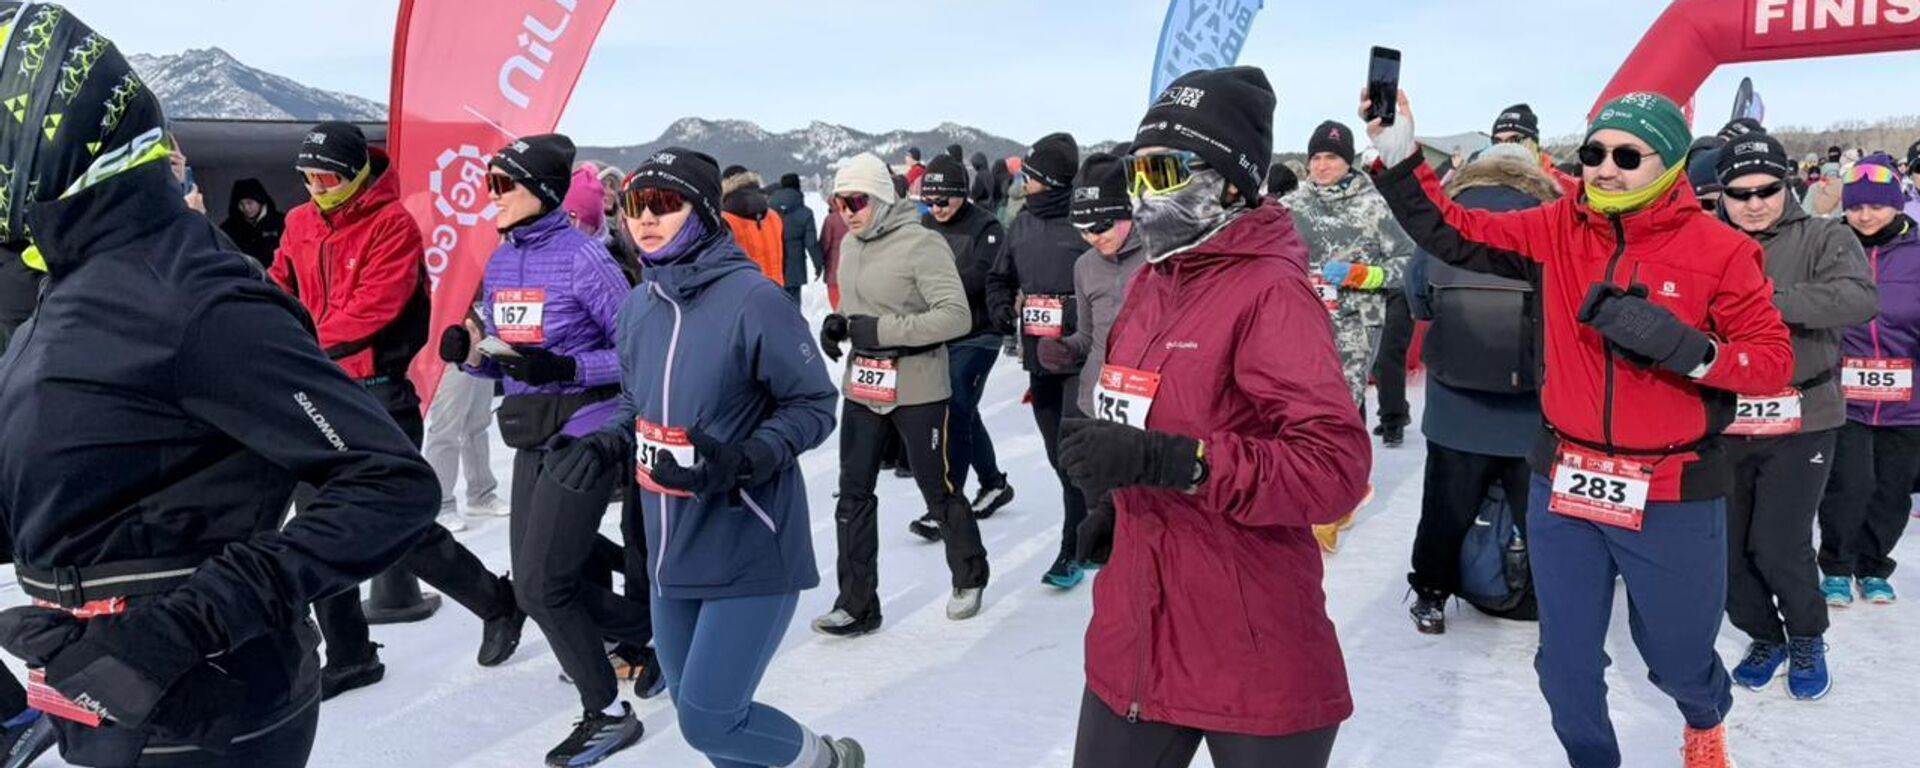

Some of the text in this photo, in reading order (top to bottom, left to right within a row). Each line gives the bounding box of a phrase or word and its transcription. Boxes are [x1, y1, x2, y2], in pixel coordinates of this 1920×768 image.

[501, 306, 528, 324] 167
[1025, 310, 1051, 323] 236
[858, 369, 885, 385] 287
[1857, 371, 1895, 387] 185
[1098, 392, 1130, 424] 135
[1738, 401, 1780, 417] 212
[294, 392, 349, 452] SALOMON
[1569, 473, 1627, 503] 283
